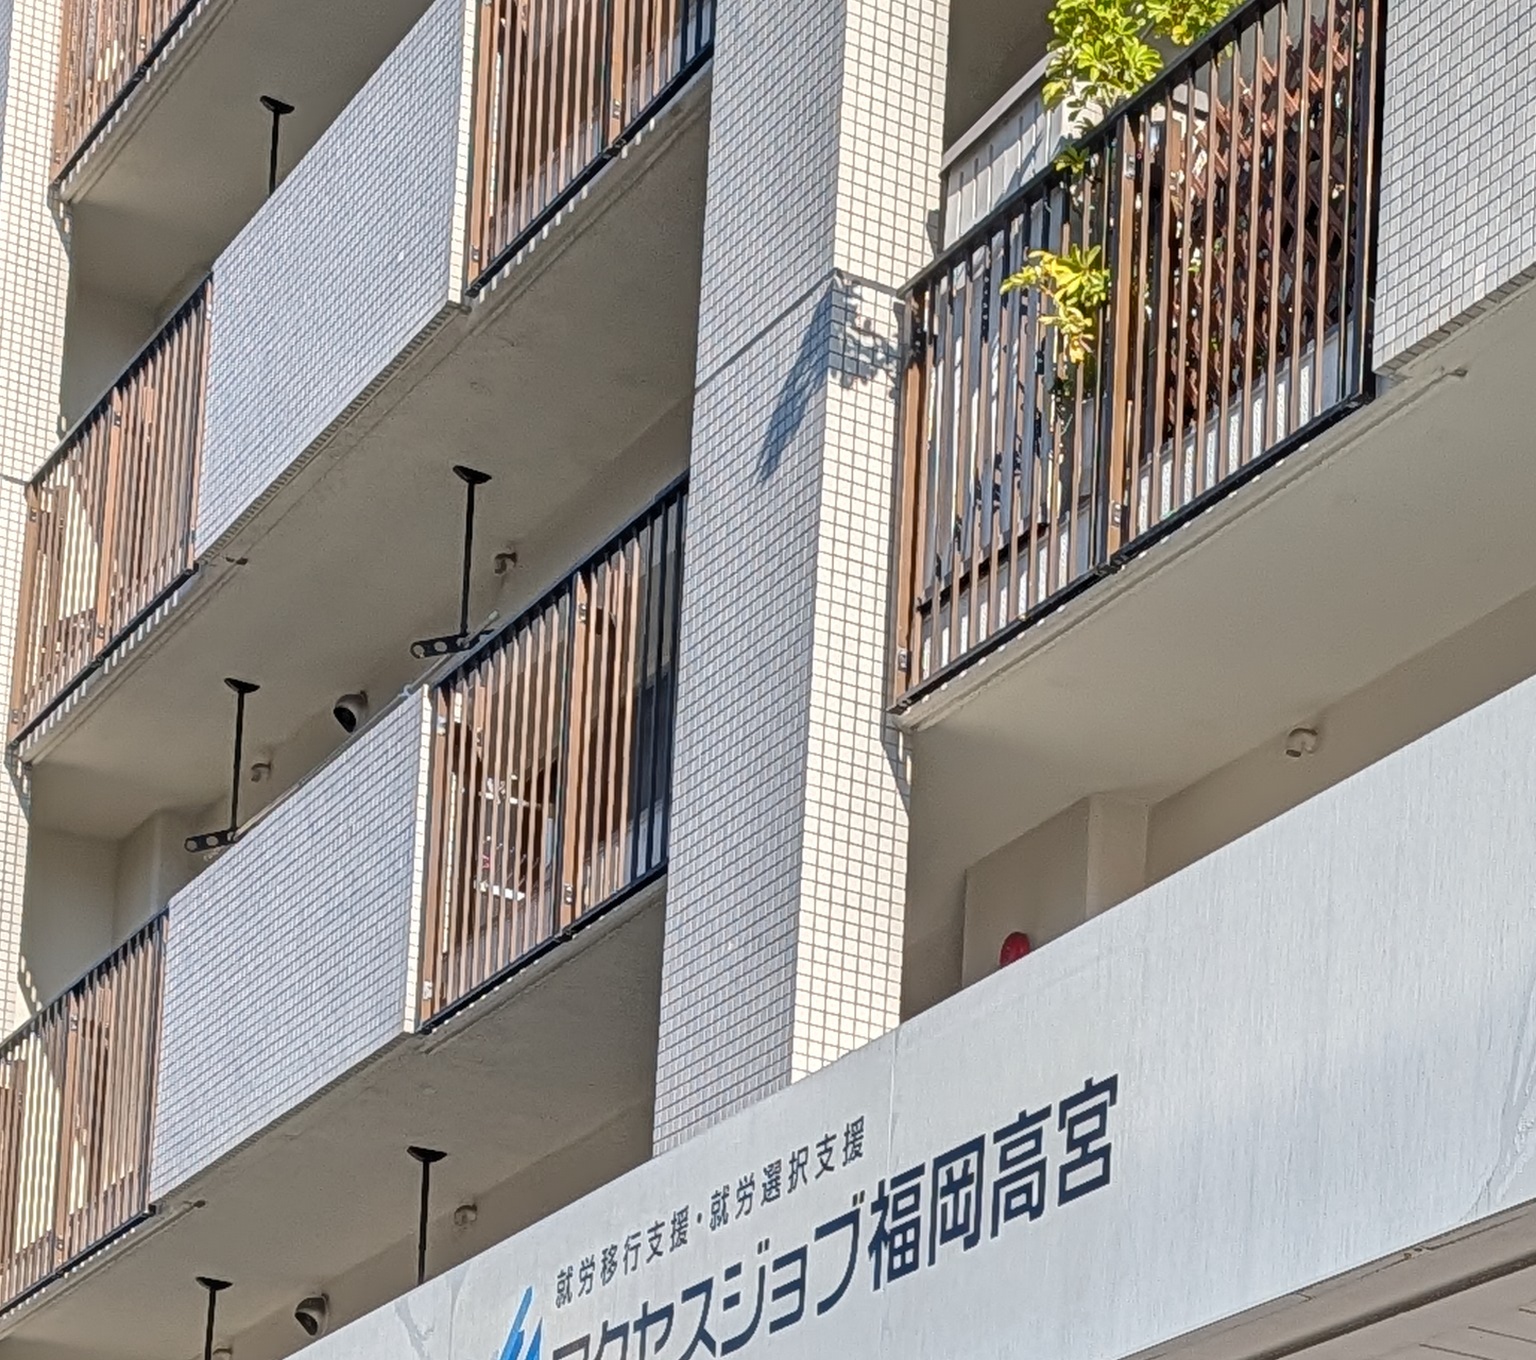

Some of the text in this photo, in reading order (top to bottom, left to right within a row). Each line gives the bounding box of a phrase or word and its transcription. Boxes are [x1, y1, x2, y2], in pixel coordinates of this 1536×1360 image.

[554, 1115, 867, 1310] 就労移行支援・就労選択支援
